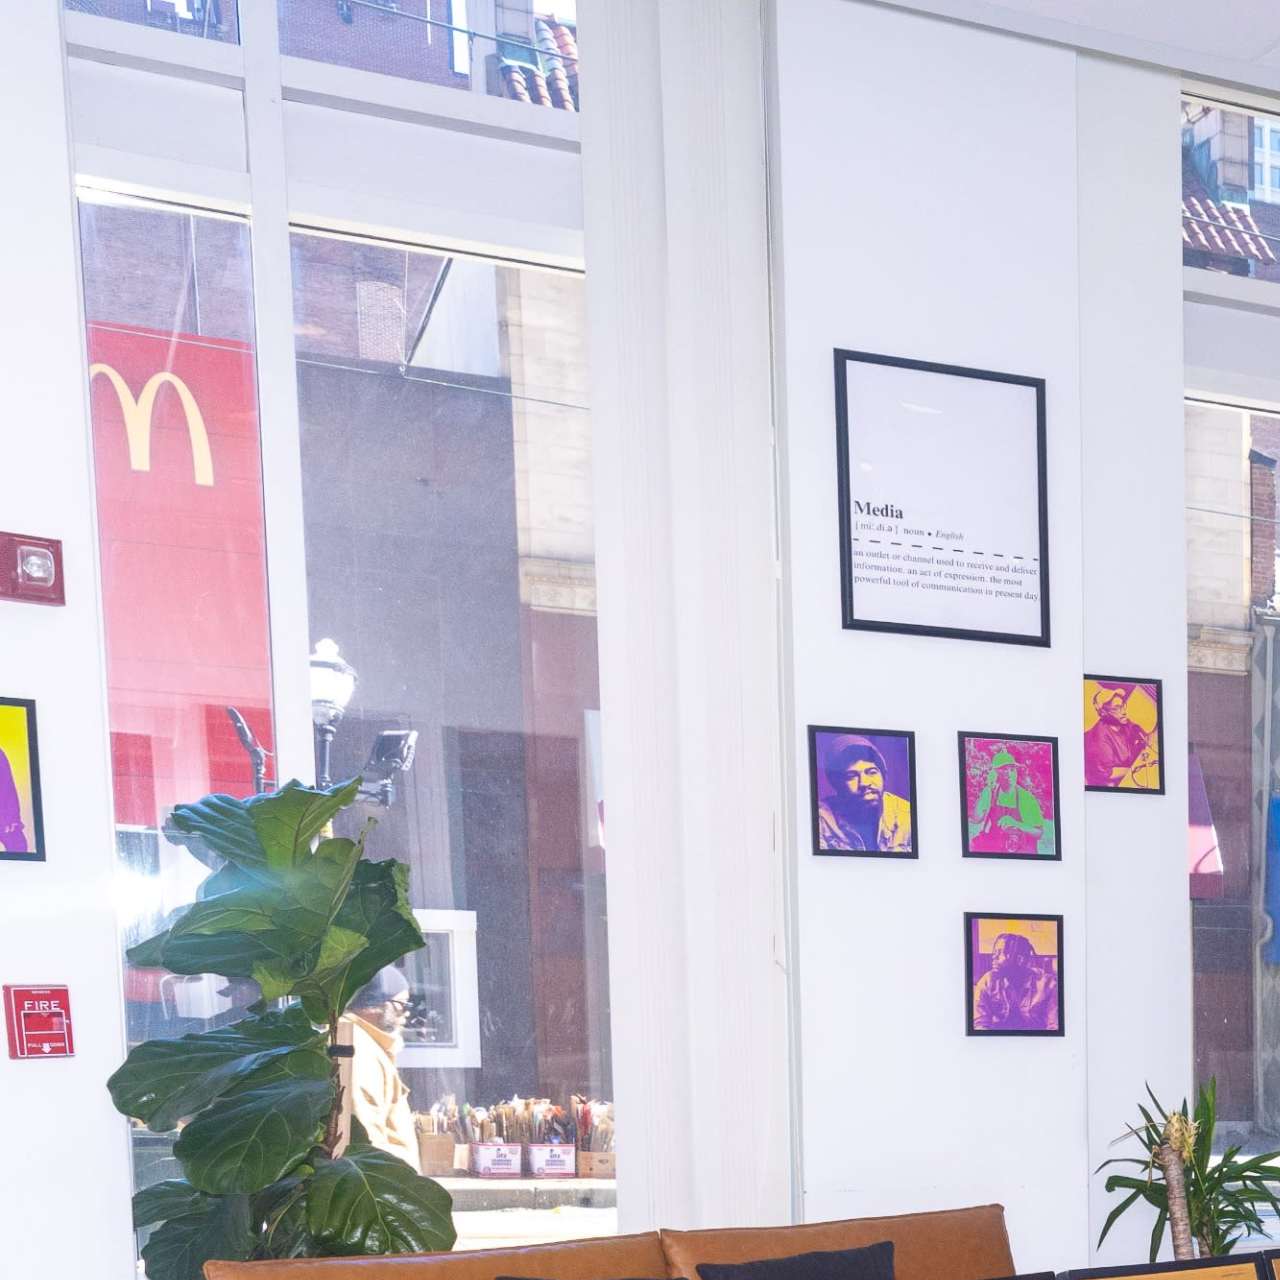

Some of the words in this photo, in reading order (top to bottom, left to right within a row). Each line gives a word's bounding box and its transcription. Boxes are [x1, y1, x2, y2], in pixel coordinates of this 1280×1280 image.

[854, 500, 904, 519] Media
[903, 527, 925, 536] noun
[935, 529, 965, 541] English
[866, 551, 890, 560] outlet
[902, 554, 934, 565] channel
[936, 558, 955, 567] used
[967, 561, 993, 571] receive
[995, 564, 1010, 573] and
[1011, 565, 1038, 576] deliver
[933, 570, 942, 578] of
[990, 575, 1002, 584] the
[1003, 577, 1023, 586] most
[854, 575, 891, 586] powerful
[893, 578, 910, 588] tool
[911, 580, 920, 588] of
[921, 583, 983, 595] communication
[985, 586, 993, 595] in
[994, 589, 1022, 599] present
[24, 1000, 60, 1011] FIRE
